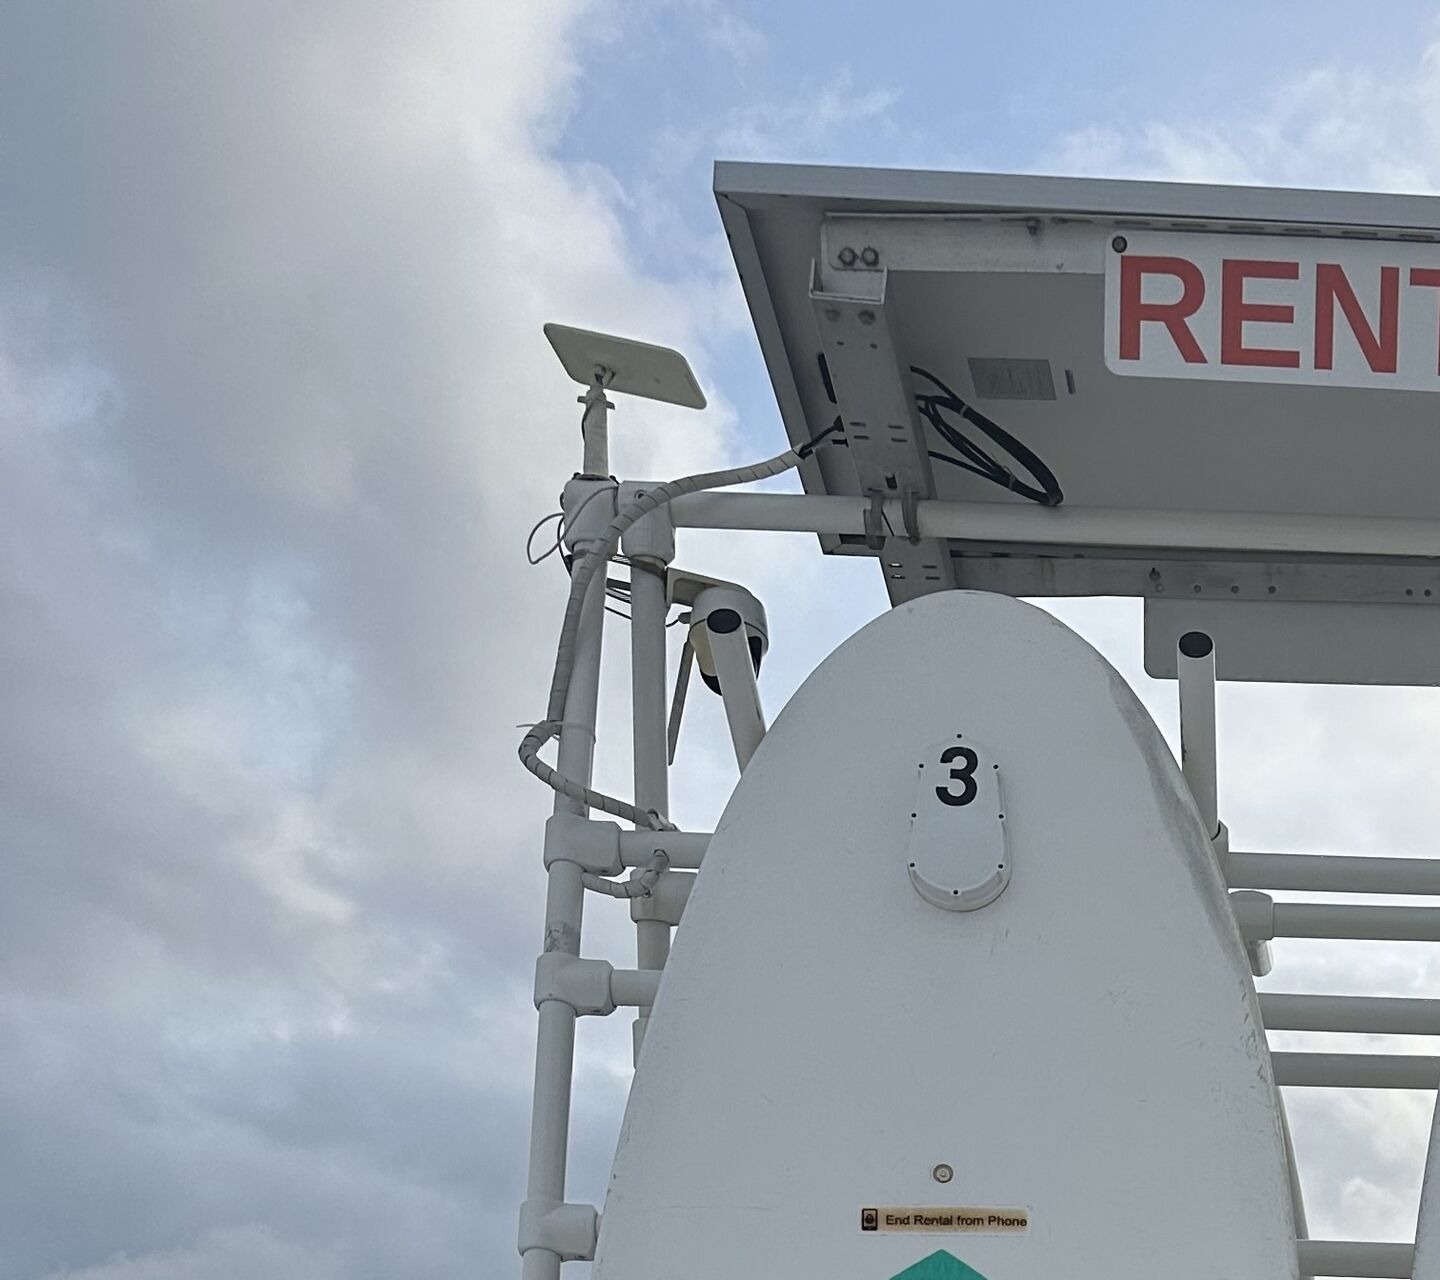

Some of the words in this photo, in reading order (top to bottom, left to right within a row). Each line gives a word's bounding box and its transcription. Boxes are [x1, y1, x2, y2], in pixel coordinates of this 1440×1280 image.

[935, 746, 979, 807] 3
[885, 1214, 910, 1225] End
[913, 1214, 953, 1226] Rental
[957, 1215, 985, 1226] from
[987, 1215, 1028, 1227] Phone
